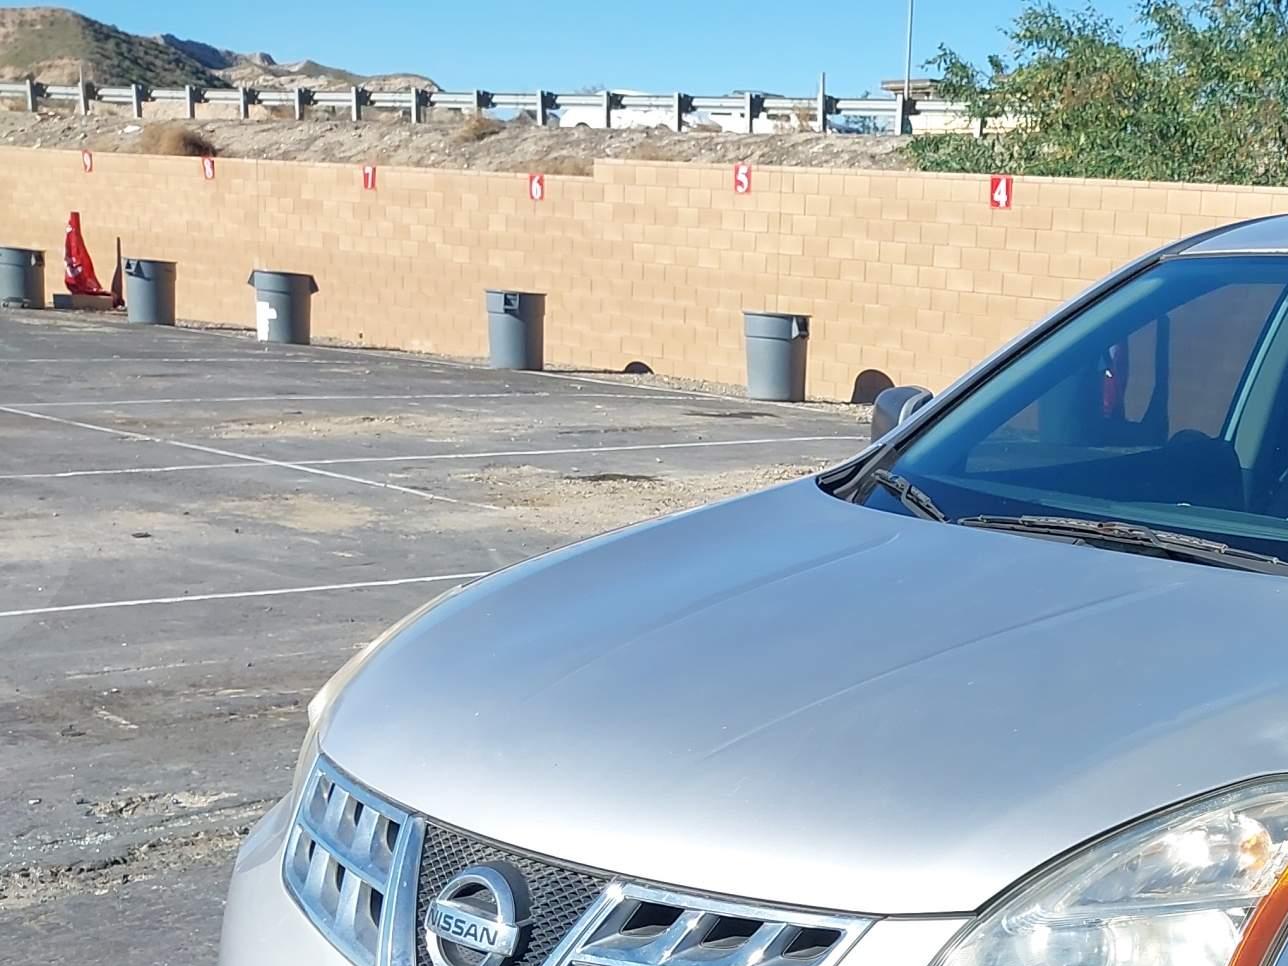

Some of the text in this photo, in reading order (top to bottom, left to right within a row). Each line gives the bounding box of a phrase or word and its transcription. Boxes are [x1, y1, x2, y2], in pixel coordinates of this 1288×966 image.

[83, 152, 91, 172] 9
[204, 158, 213, 178] 8
[364, 166, 373, 189] 7
[531, 175, 542, 200] 6
[736, 166, 749, 193] 5
[993, 178, 1008, 208] 4
[427, 907, 499, 946] NISSAN
